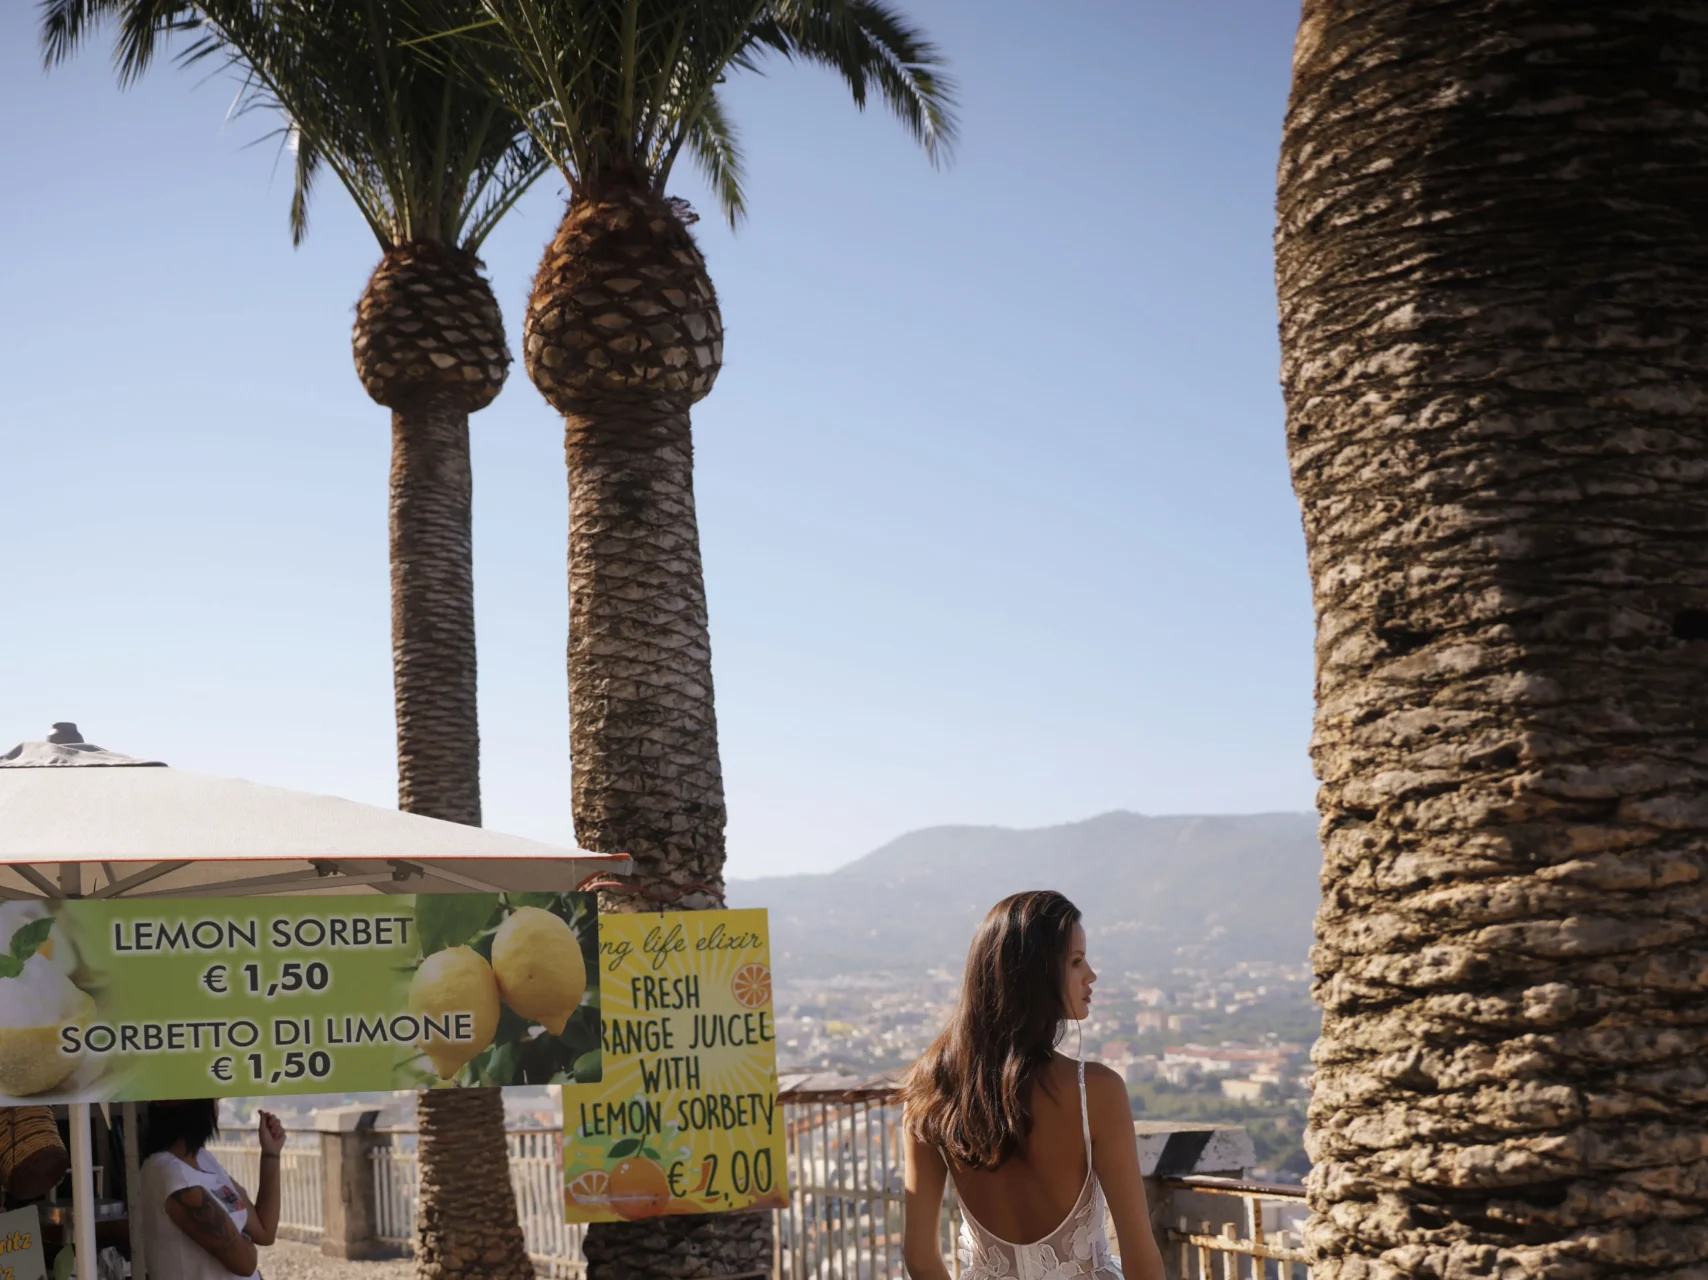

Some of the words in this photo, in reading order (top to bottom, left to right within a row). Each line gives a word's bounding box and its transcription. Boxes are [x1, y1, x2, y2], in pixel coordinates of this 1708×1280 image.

[115, 920, 256, 950] LEMON
[272, 918, 413, 947] SORBET
[643, 924, 687, 970] life
[696, 923, 763, 950] elixir
[203, 965, 227, 992] €
[244, 962, 328, 996] 1,50
[631, 974, 700, 1011] FRESH
[61, 1021, 258, 1053] SORBETTO
[275, 1019, 310, 1045] DI
[327, 1014, 472, 1043] LIMONE
[601, 1017, 673, 1055] RANGE
[211, 1057, 232, 1080] €
[248, 1051, 331, 1083] 1,50
[639, 1056, 700, 1094] WITH
[580, 1100, 661, 1138] LEMON
[667, 1161, 687, 1198] €
[703, 1147, 772, 1205] 2,00
[0, 1230, 32, 1256] ritz
